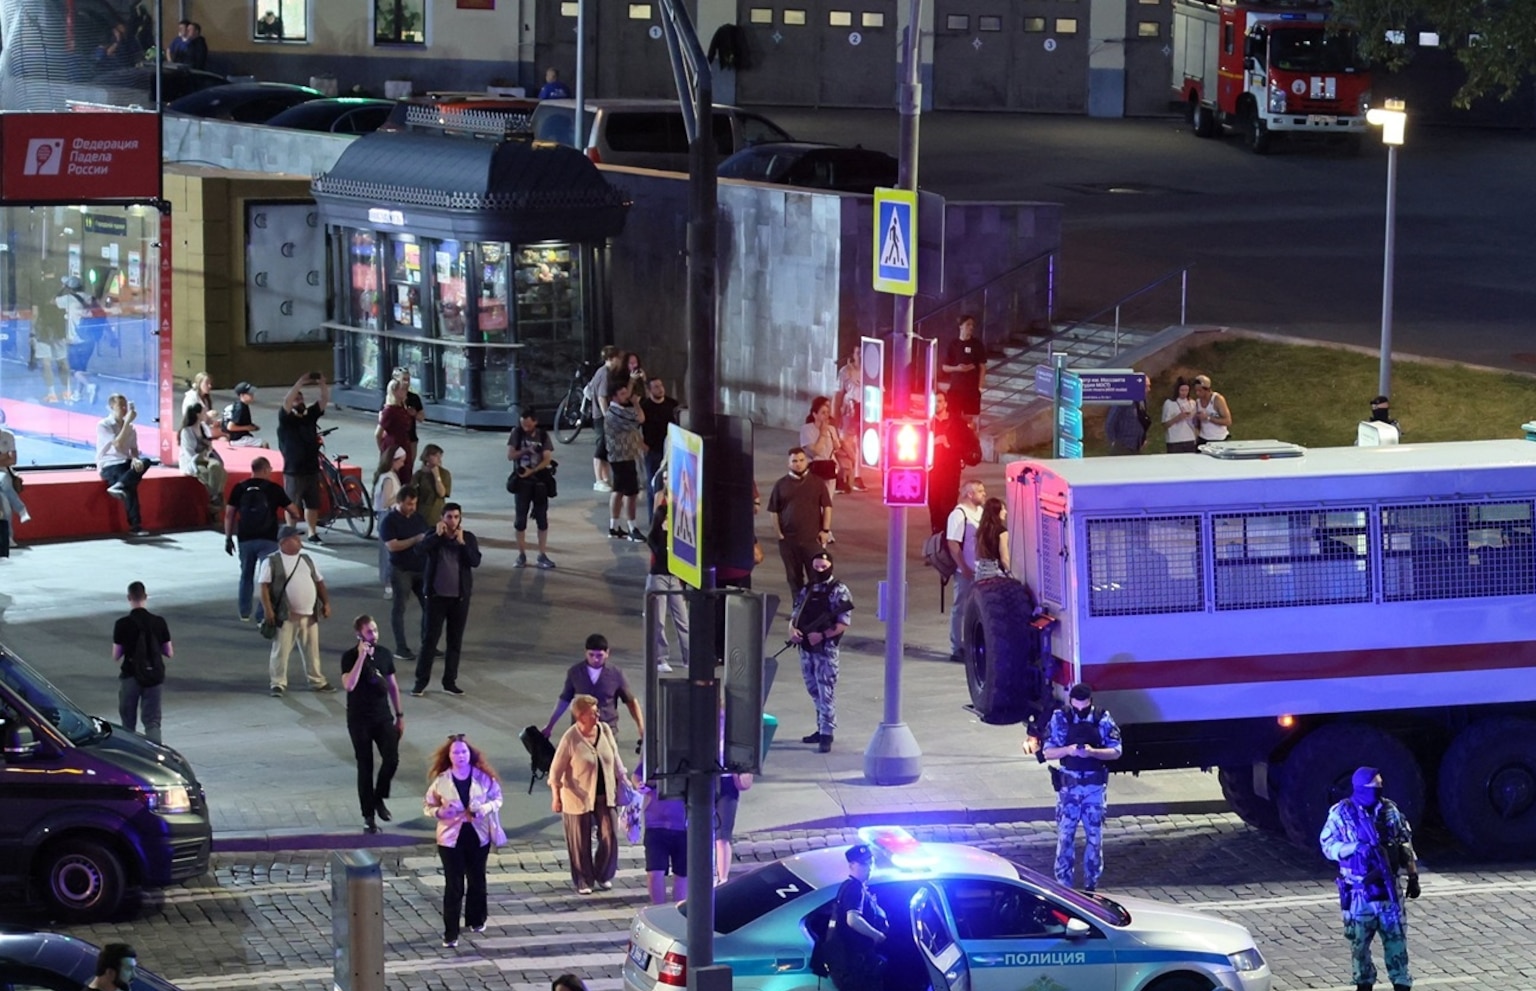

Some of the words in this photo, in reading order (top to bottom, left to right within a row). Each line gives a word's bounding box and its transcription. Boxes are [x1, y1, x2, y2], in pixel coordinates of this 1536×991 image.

[72, 138, 139, 150] Федерация
[69, 151, 112, 163] Падела
[67, 163, 109, 175] России
[1004, 951, 1086, 966] ПОЛИЦИЯ
